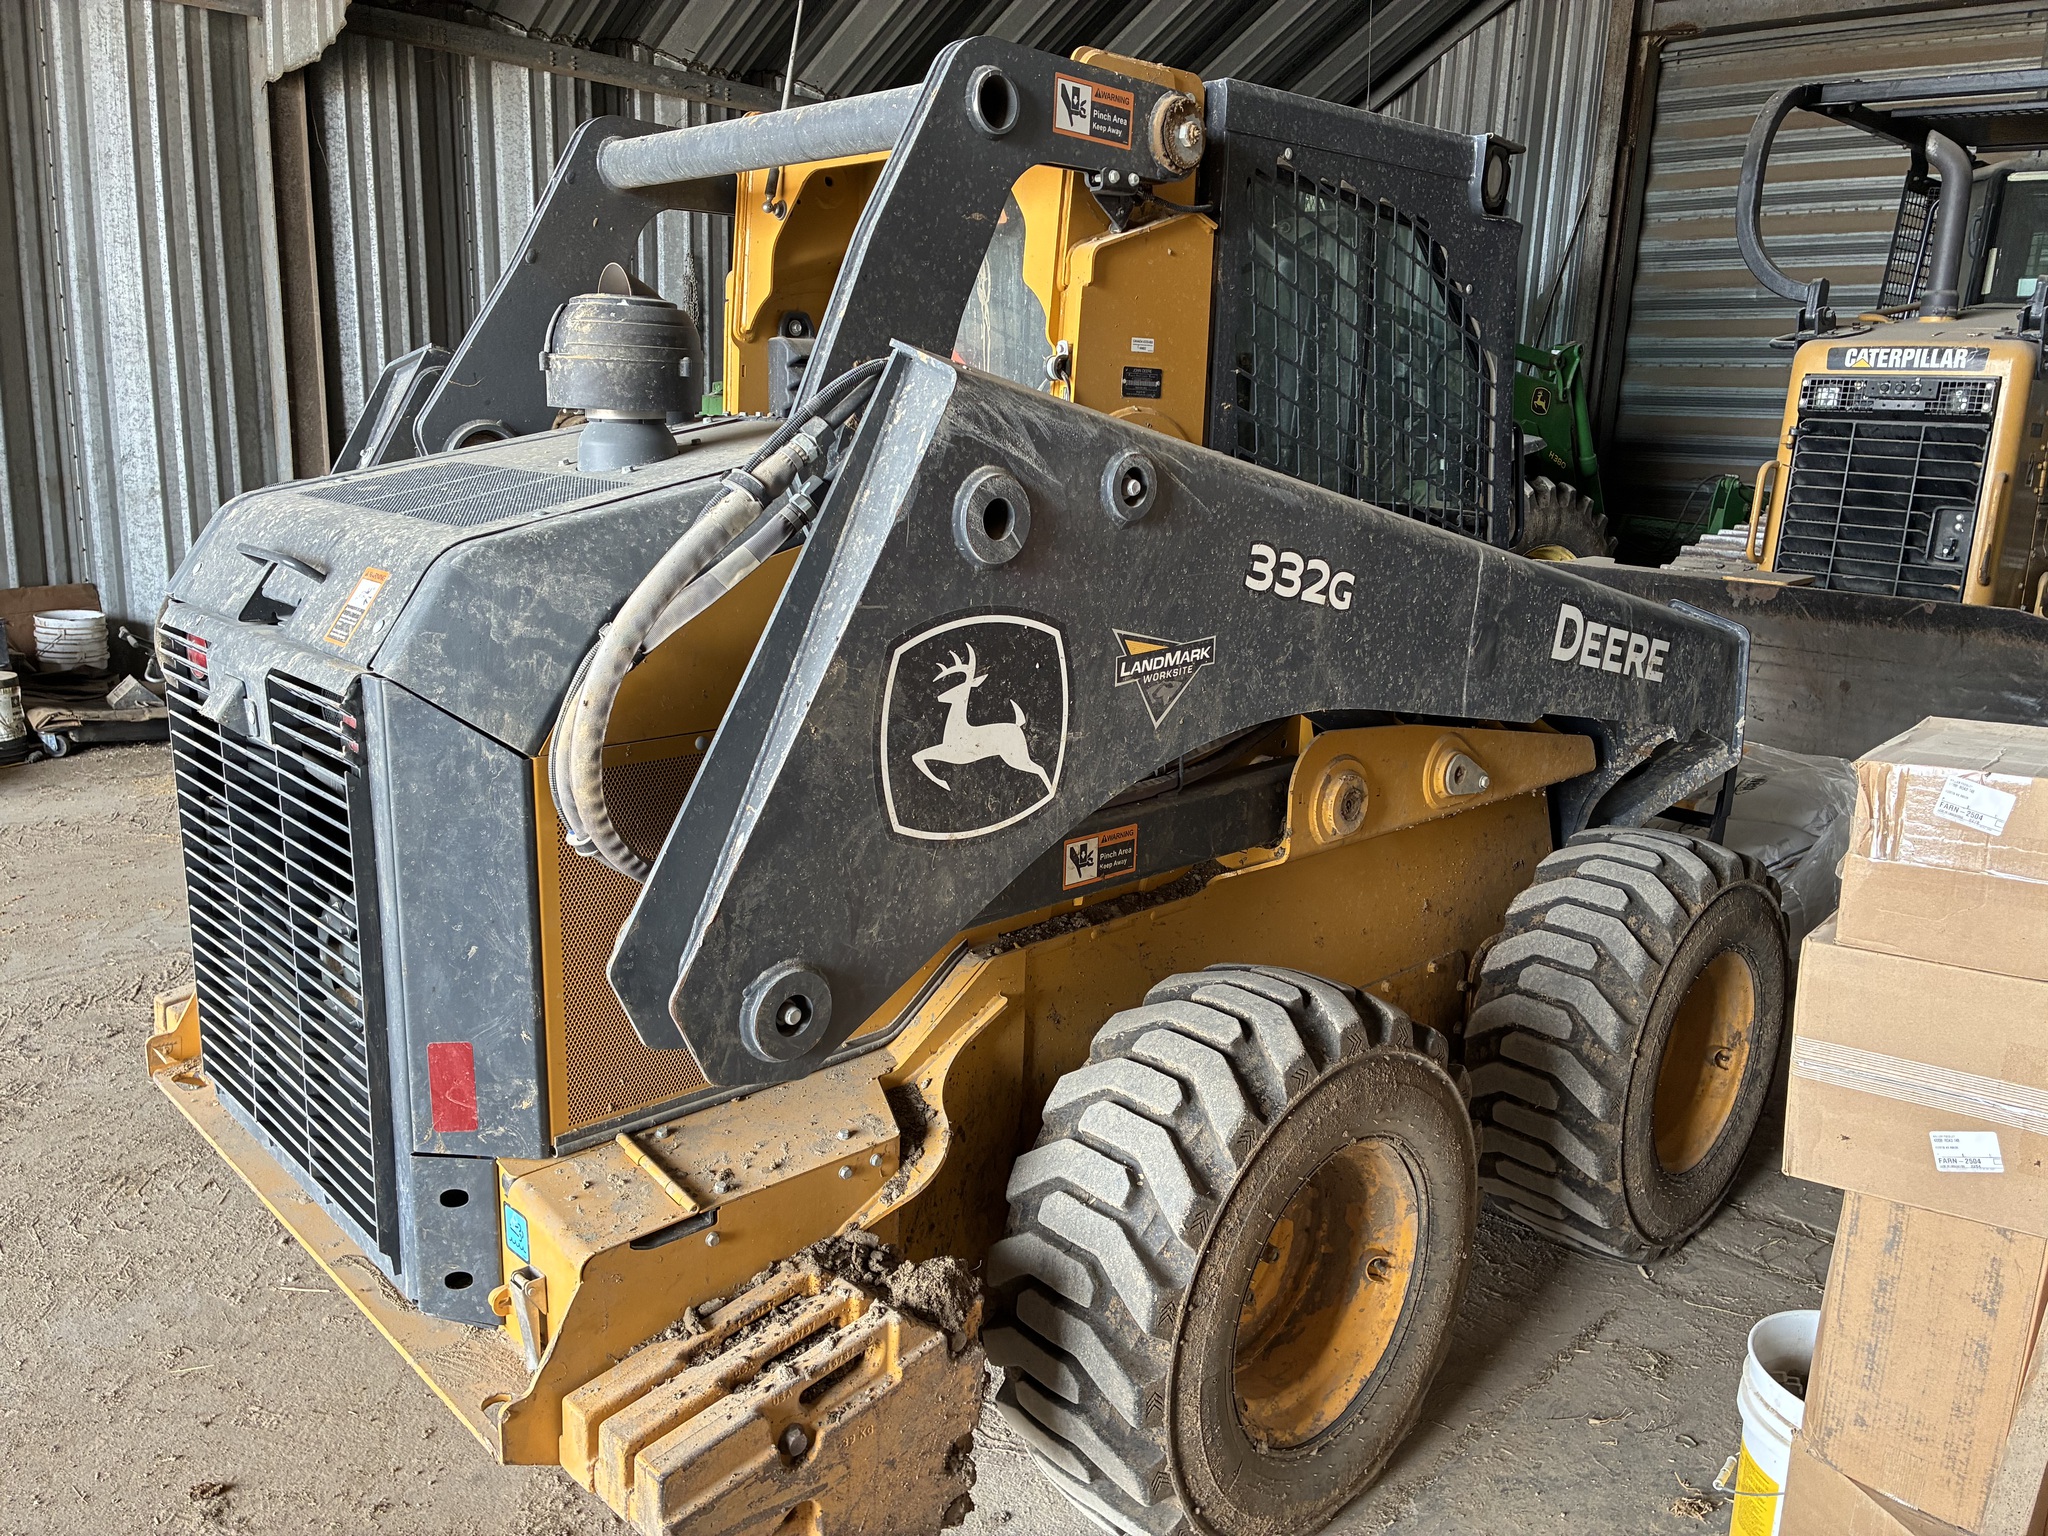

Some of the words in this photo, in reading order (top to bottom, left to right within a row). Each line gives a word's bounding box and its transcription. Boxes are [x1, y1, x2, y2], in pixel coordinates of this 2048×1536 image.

[1101, 91, 1130, 106] WARNING
[1093, 109, 1112, 121] Pinch
[1112, 115, 1128, 126] Area
[1092, 122, 1107, 133] Keep
[1107, 126, 1123, 137] Away
[1844, 348, 1969, 369] CATERPILLAR
[1548, 450, 1567, 469] H380
[1244, 543, 1356, 611] 332G
[1551, 603, 1671, 683] DEERE
[1120, 645, 1212, 678] LANDMARK
[1143, 664, 1194, 684] WORKSITE
[1939, 801, 1960, 813] FARN
[1107, 829, 1134, 842] WARNING
[1100, 850, 1117, 861] Pinch
[1117, 847, 1132, 857] Area
[1100, 862, 1113, 870] Keep
[1113, 858, 1128, 867] Away
